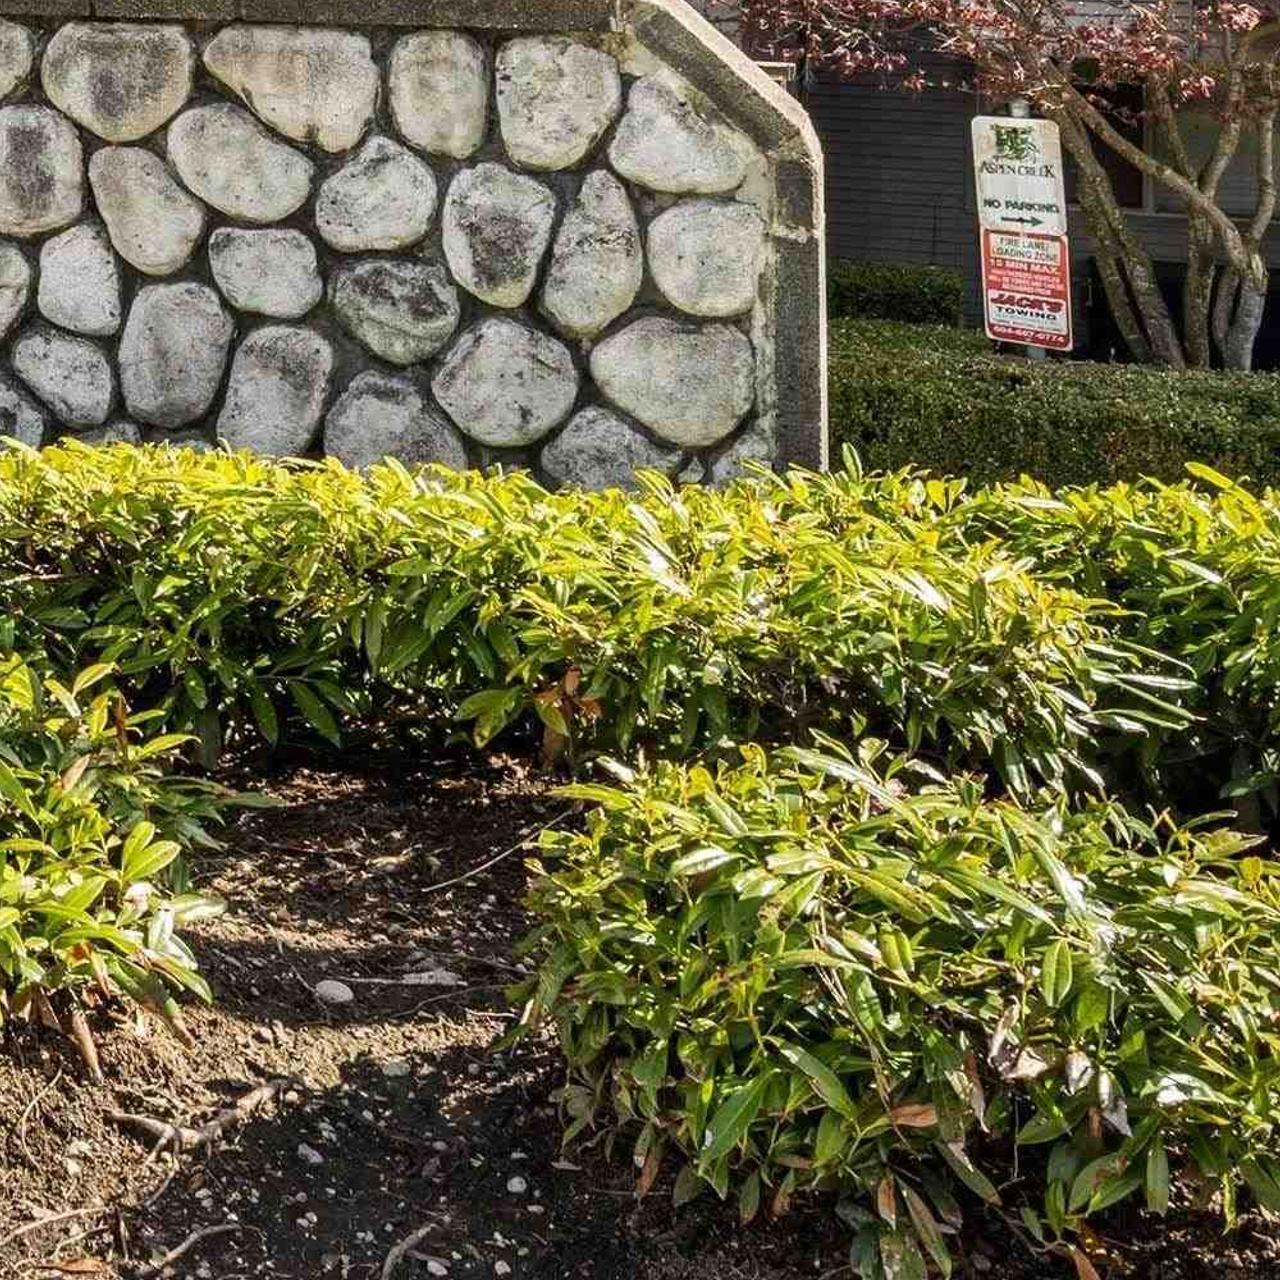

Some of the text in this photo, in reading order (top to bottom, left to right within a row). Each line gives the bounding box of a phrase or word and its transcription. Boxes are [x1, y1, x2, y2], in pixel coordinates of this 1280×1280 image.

[983, 199, 1060, 214] NO PARKING
[996, 306, 1057, 320] TOWING
